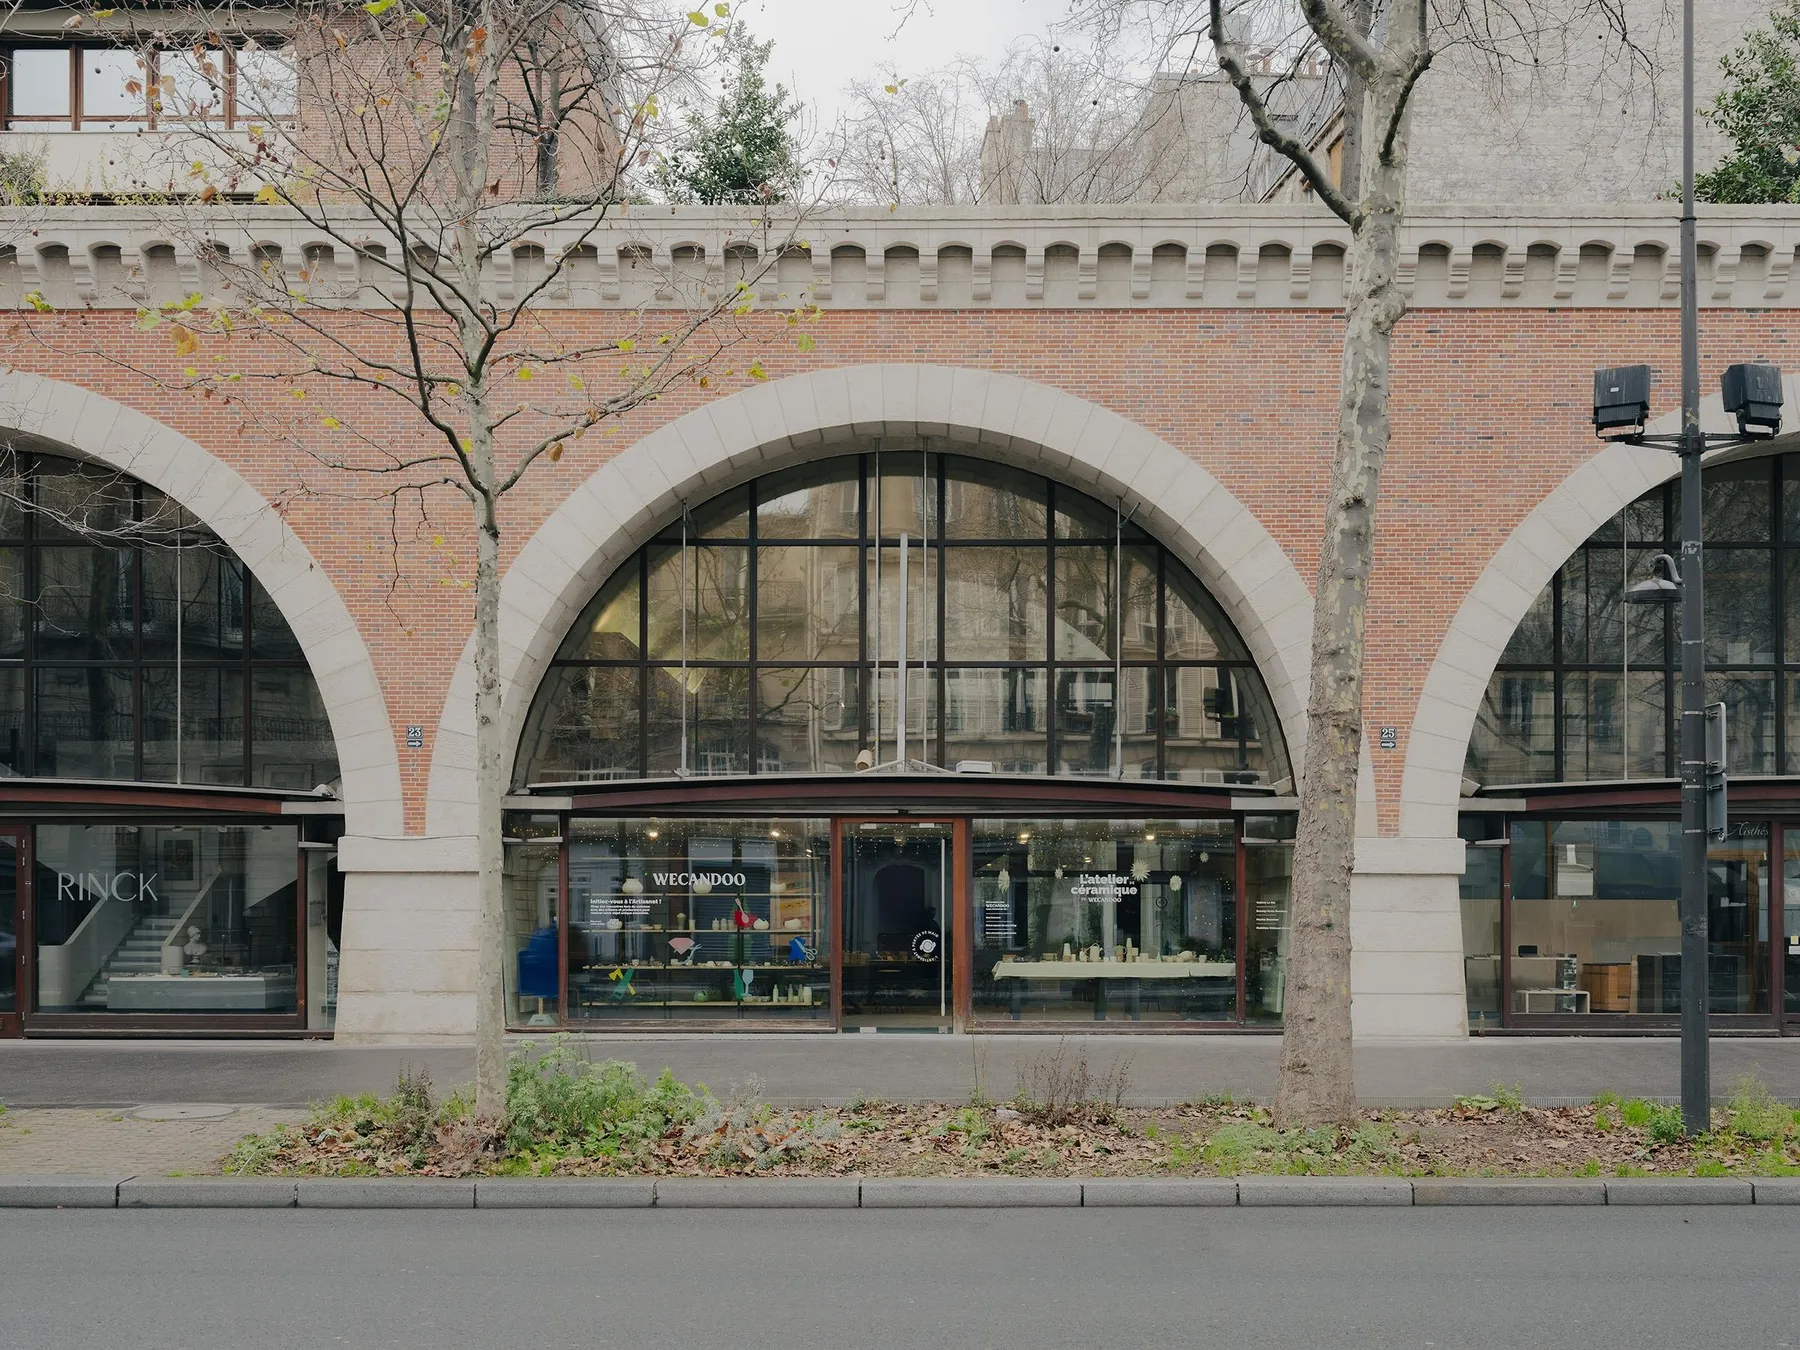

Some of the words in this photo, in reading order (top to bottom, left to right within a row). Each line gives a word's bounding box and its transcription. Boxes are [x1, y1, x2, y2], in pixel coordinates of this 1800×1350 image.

[408, 727, 421, 737] 23
[1382, 728, 1395, 738] 25
[652, 872, 746, 886] WECANDOO
[1079, 873, 1129, 885] L'atelier
[57, 872, 158, 902] RINCK
[1070, 884, 1138, 897] céramique
